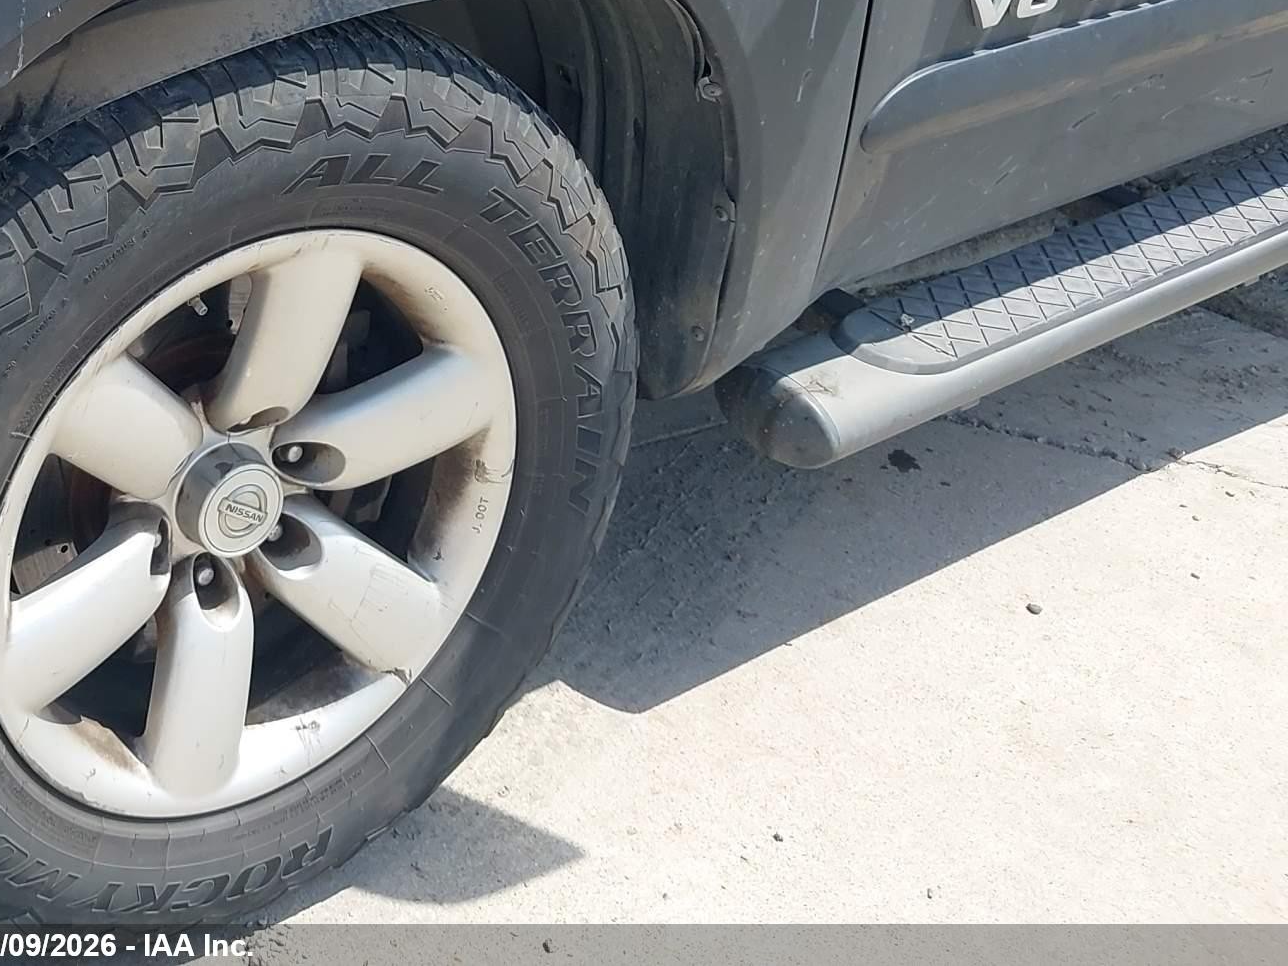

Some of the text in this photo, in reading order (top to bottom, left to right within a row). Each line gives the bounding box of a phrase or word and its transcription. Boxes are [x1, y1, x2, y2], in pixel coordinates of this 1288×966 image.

[70, 826, 333, 913] ROCKY
[280, 153, 444, 195] ALL
[479, 186, 604, 516] TERRAIN
[225, 503, 264, 523] NISSAN
